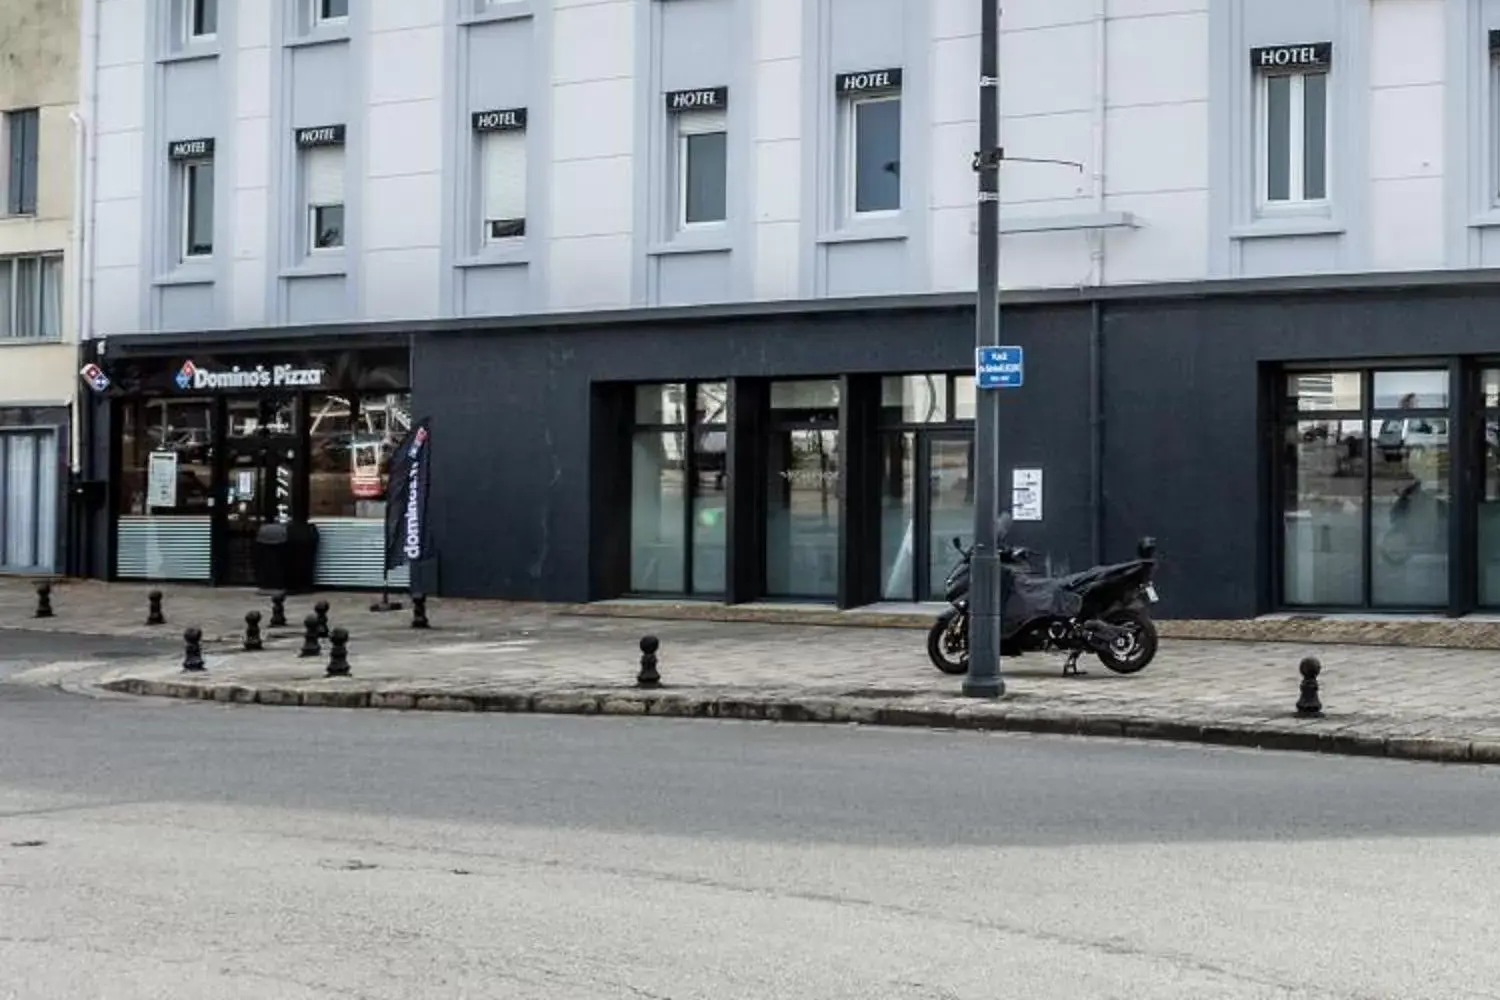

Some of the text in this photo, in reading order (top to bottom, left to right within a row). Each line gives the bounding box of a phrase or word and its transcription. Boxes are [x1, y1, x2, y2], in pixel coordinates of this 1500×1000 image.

[1261, 47, 1318, 65] HOTEL
[844, 72, 890, 90] HOTEL
[673, 91, 716, 107] HOTEL
[478, 112, 517, 126] HOTEL
[301, 128, 335, 143] HOTEL
[175, 141, 207, 155] HOTEL
[194, 363, 321, 389] Domino's Pizza
